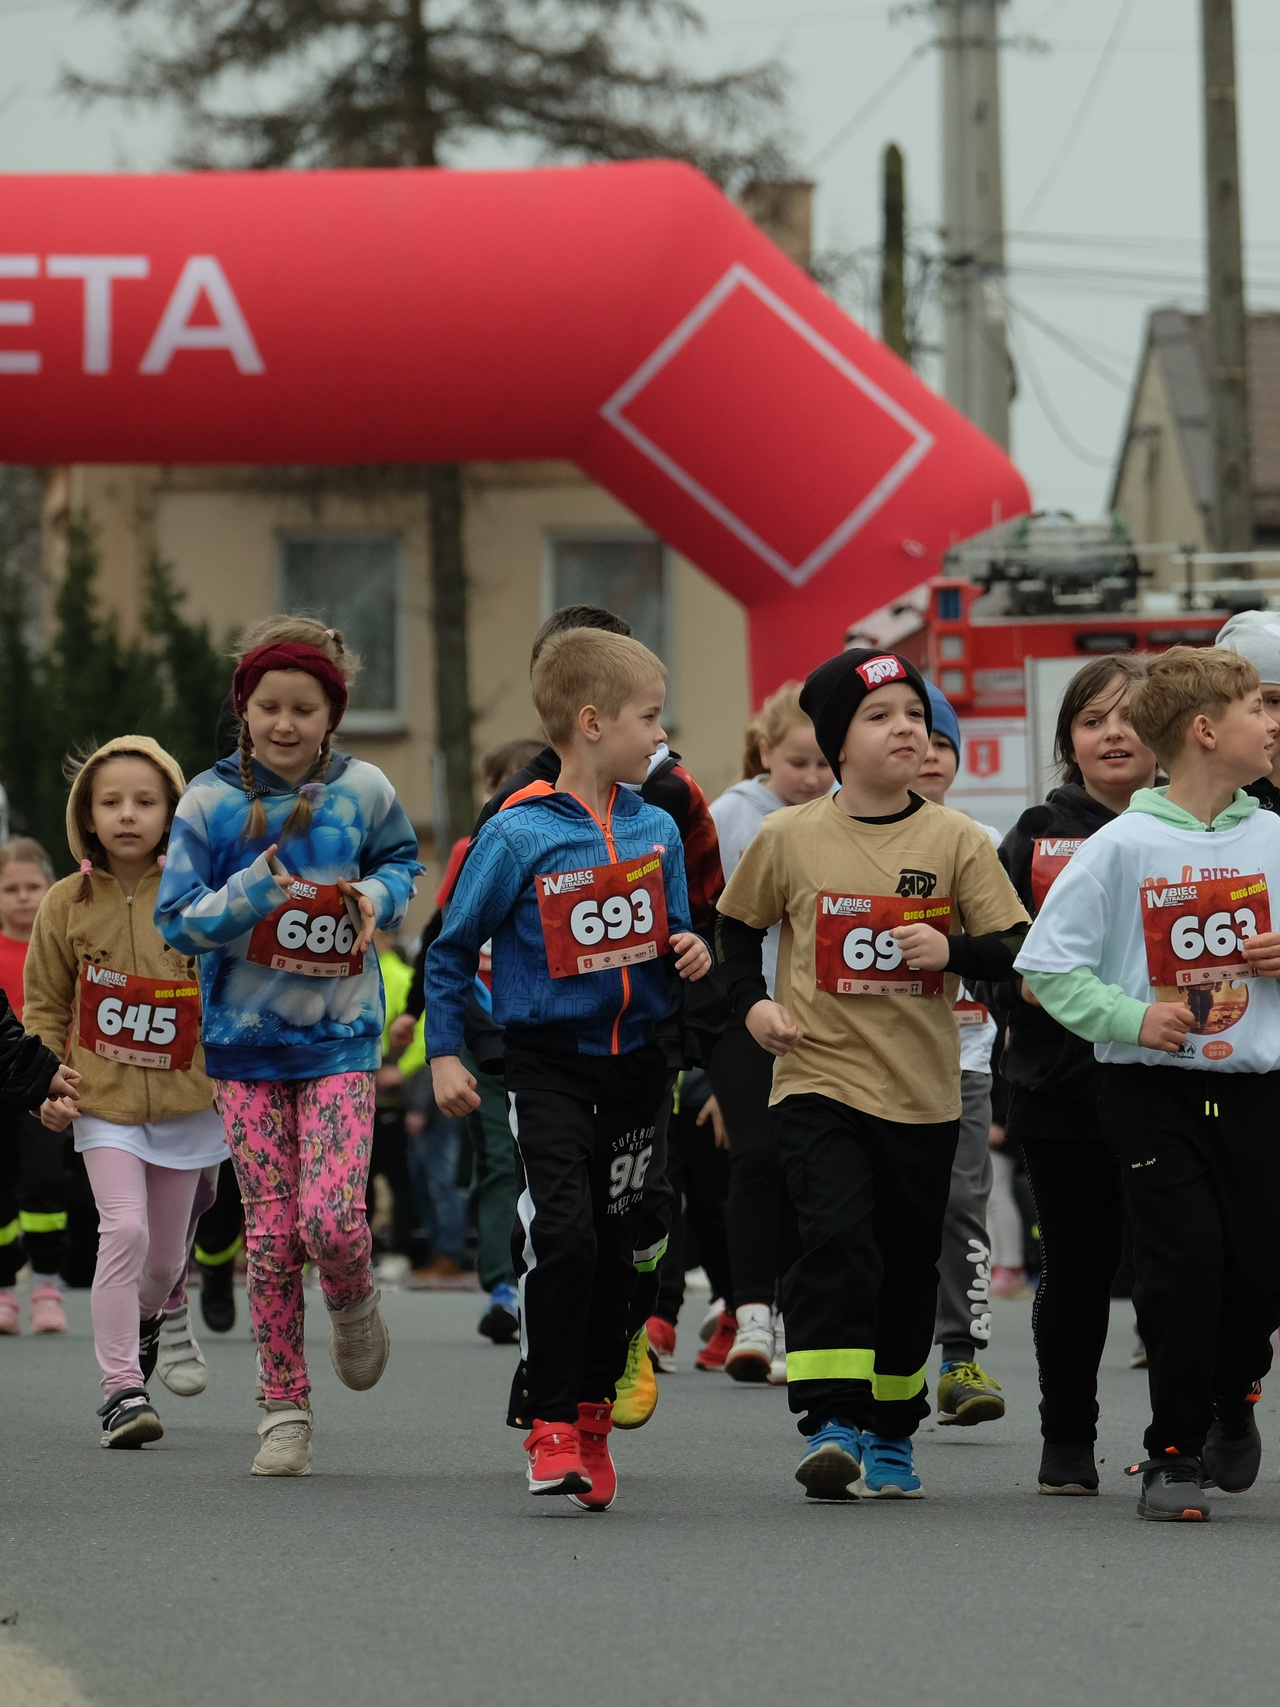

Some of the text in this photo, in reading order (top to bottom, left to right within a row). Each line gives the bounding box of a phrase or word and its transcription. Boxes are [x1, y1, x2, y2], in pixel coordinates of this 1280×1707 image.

[543, 870, 594, 895] IV BIEG
[626, 859, 660, 883] BIEG DZIECI
[292, 881, 318, 895] BIEG
[561, 879, 594, 889] STRAŻAKA
[1230, 881, 1267, 901] BIEG DZIECI
[822, 896, 872, 915] IV BIEG
[1146, 886, 1197, 908] IV BIEG
[570, 888, 653, 945] 693
[903, 906, 951, 921] BIEG DZIECI
[276, 909, 354, 954] 686
[1170, 907, 1258, 960] 663
[843, 927, 920, 971] 69
[86, 965, 127, 984] IV BIEG
[155, 987, 198, 998] BIEG DZIECI
[97, 997, 177, 1045] 645
[608, 1144, 653, 1199] 96
[965, 1239, 992, 1340] Bluey
